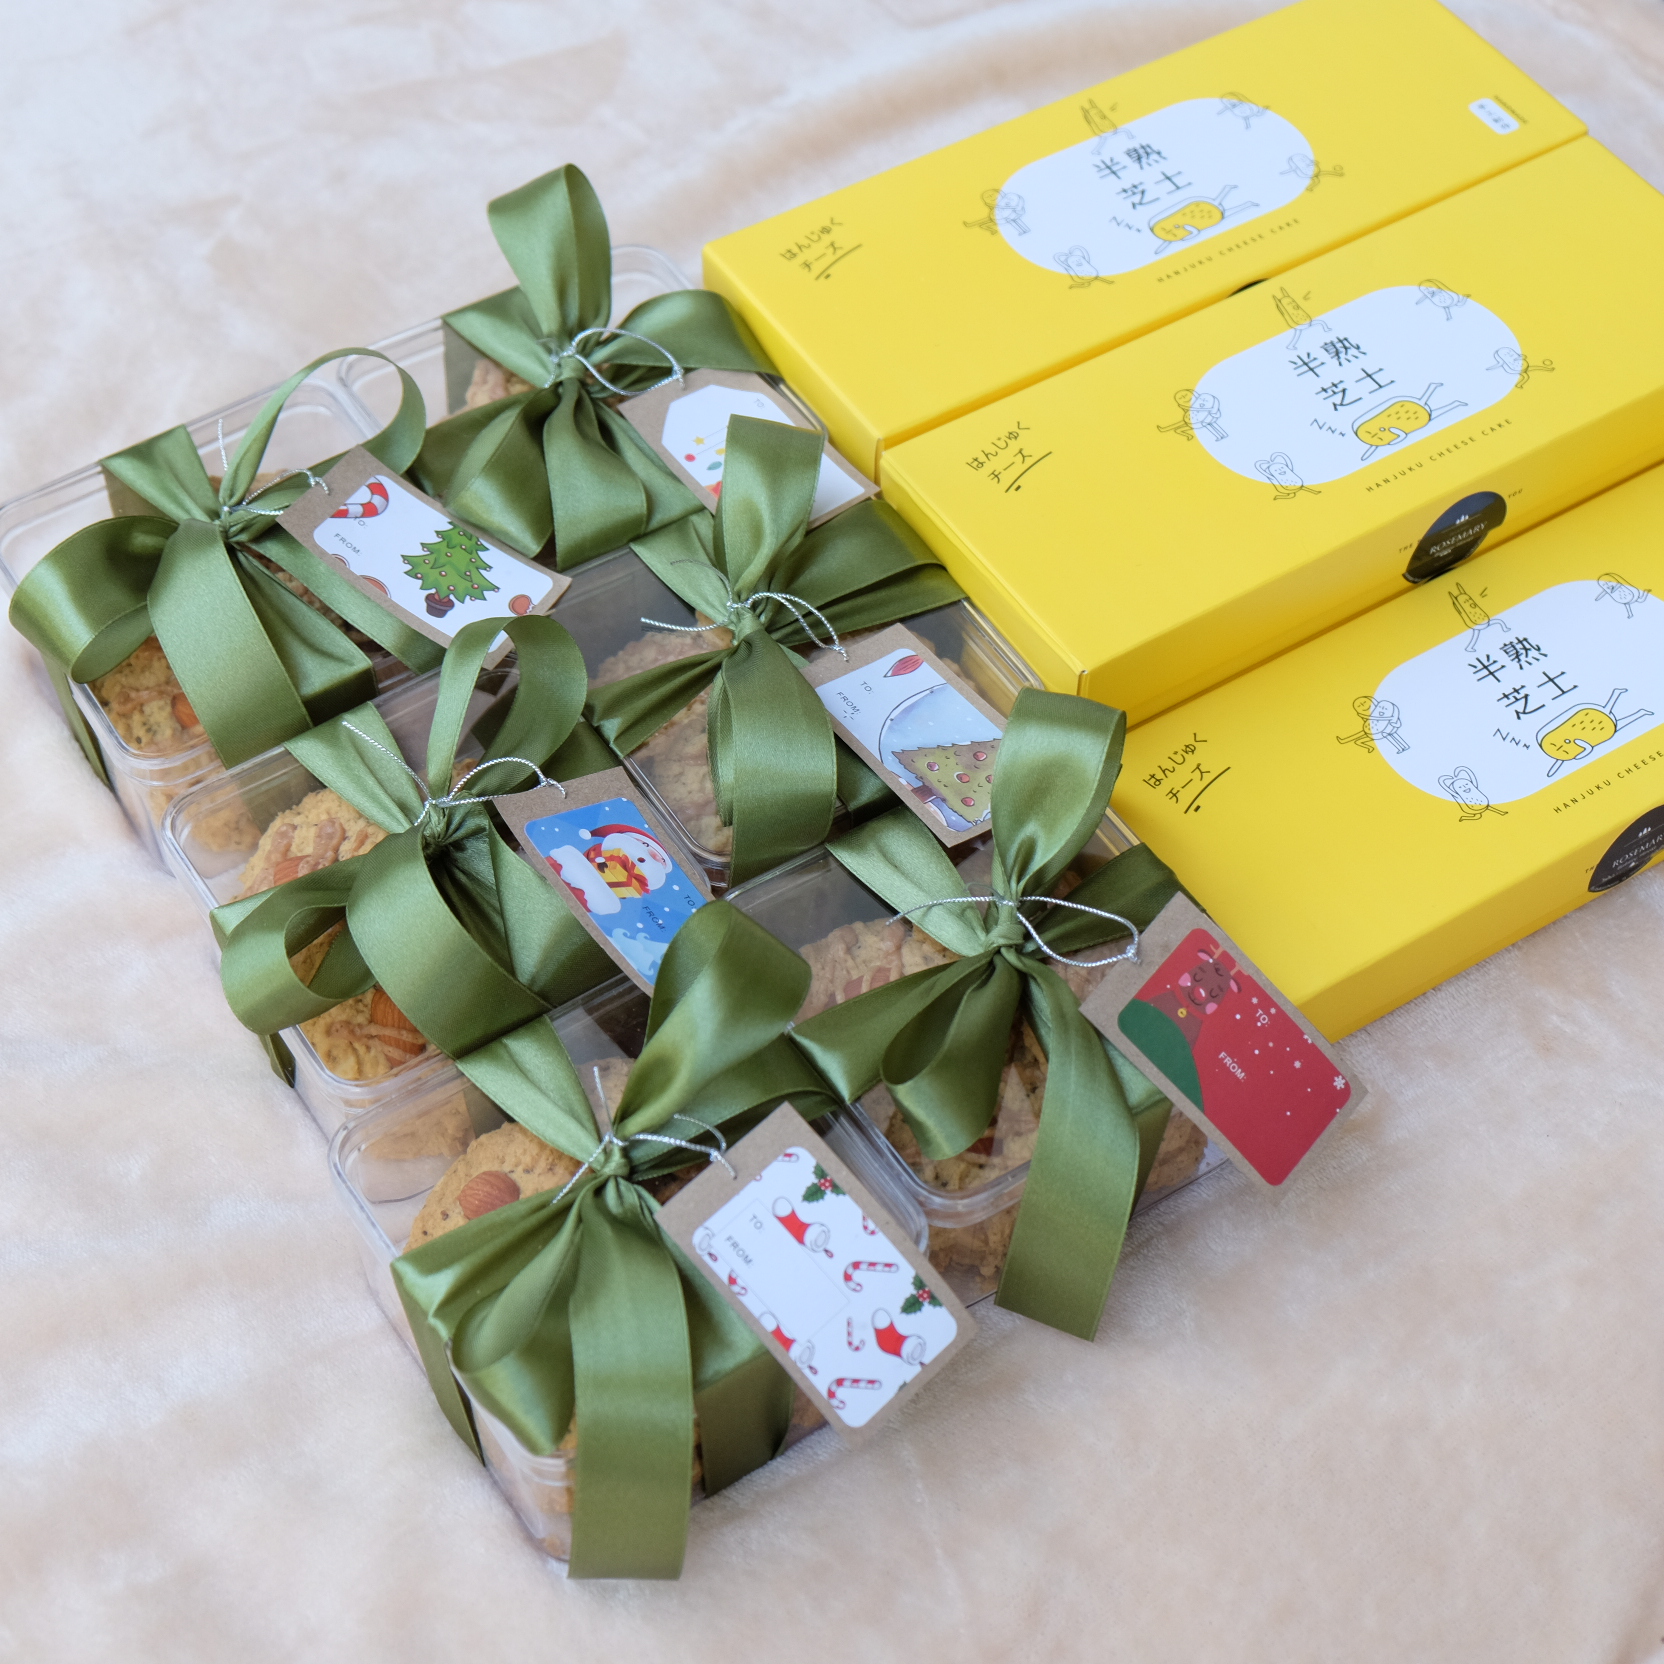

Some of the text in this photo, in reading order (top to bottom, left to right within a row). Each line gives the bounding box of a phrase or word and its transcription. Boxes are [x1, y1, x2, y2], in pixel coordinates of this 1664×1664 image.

[1092, 143, 1168, 180] 半熟
[1116, 170, 1192, 210] 芝士
[779, 216, 844, 261] はんじゅく
[1156, 217, 1301, 283] HANJUKU CHEESE CAKE
[1288, 335, 1368, 378] 半熟
[1314, 367, 1396, 412] 芝士
[965, 420, 1031, 472] はんじゅく
[987, 447, 1033, 485] チーズ
[1365, 418, 1513, 493] HANJUKU CHEESE CAKE
[1429, 520, 1488, 556] ROSEMARY
[1467, 636, 1548, 683] 半熟
[1497, 670, 1579, 720] 芝士
[1142, 732, 1208, 790] はんじゅく
[1165, 762, 1211, 805] チーズ
[1552, 750, 1664, 815] HANJUKU CHEESE
[1612, 833, 1664, 869] ROSEMAR
